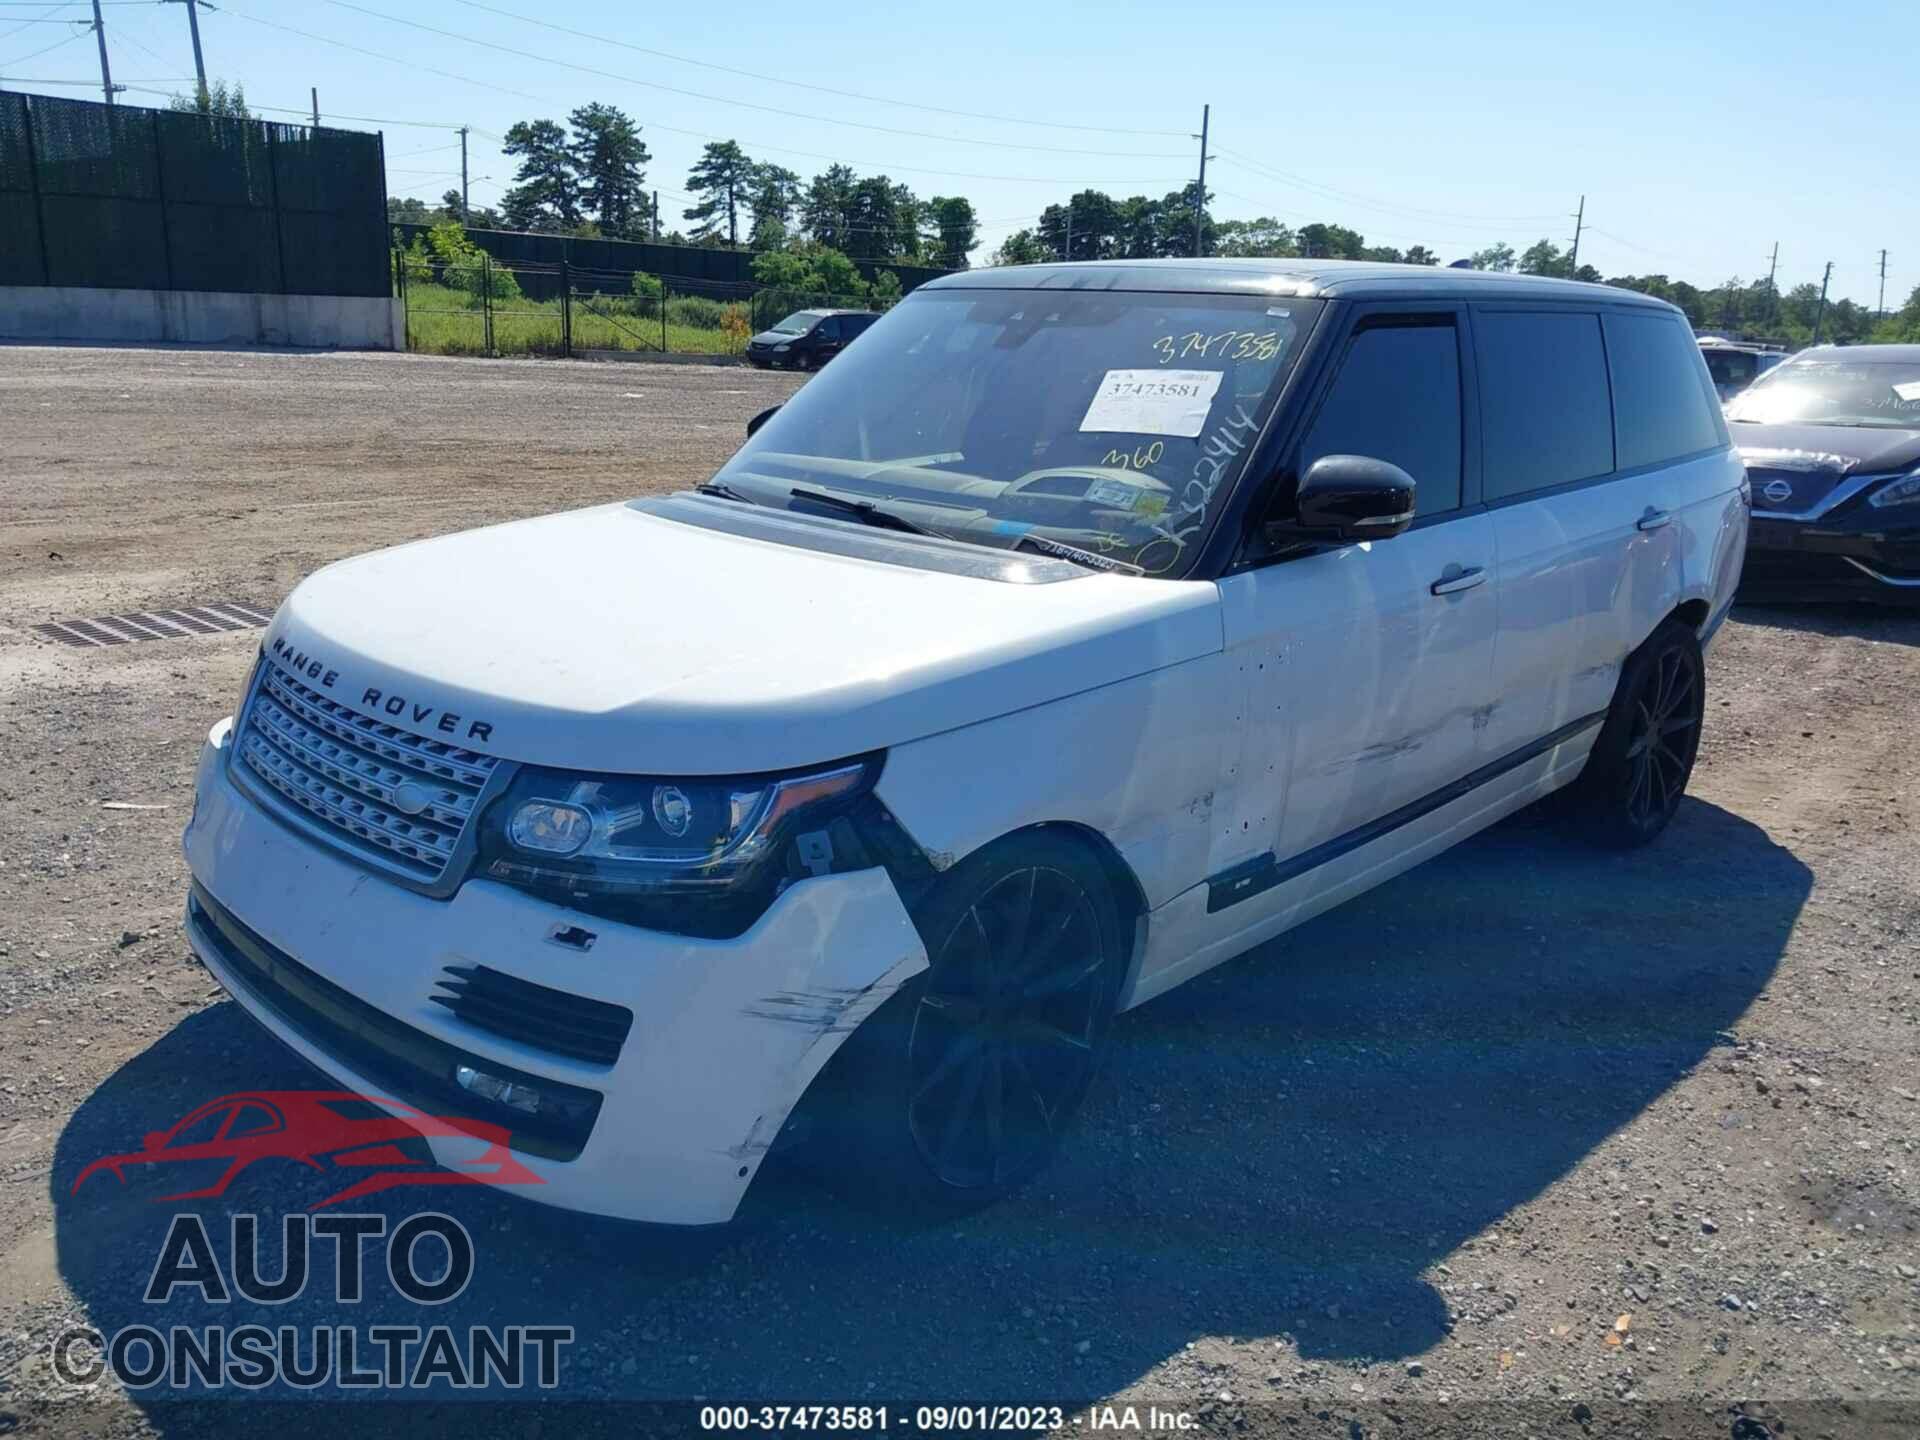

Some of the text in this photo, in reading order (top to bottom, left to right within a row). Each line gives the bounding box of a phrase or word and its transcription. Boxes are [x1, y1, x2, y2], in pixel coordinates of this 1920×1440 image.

[1107, 382, 1200, 398] 37473581
[272, 639, 494, 742] RANGE ROVER
